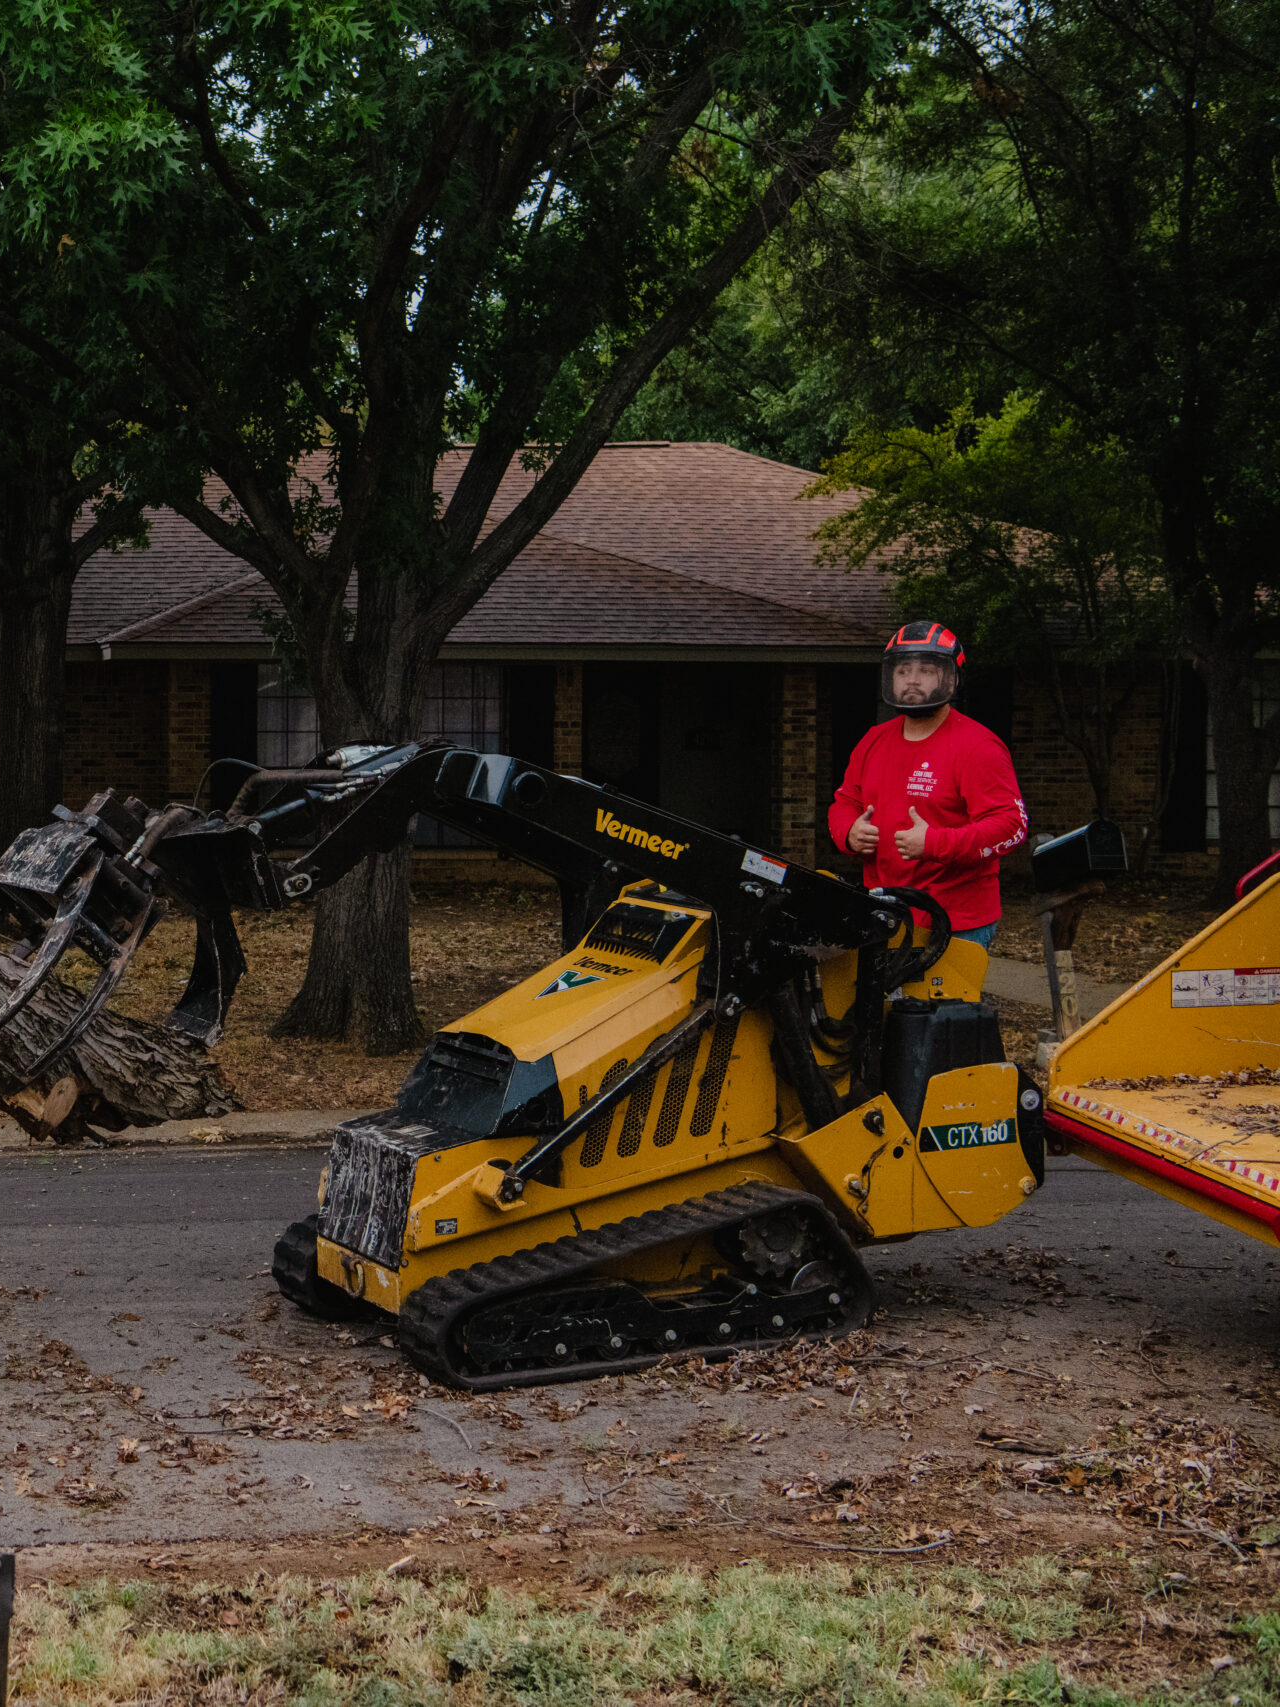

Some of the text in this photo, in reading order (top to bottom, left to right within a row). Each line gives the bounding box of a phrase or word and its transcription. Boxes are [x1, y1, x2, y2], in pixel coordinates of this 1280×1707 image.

[595, 808, 686, 860] Vermeer
[992, 827, 1024, 853] TREE
[572, 956, 634, 976] Vermeer
[948, 1122, 1008, 1147] CTX 160
